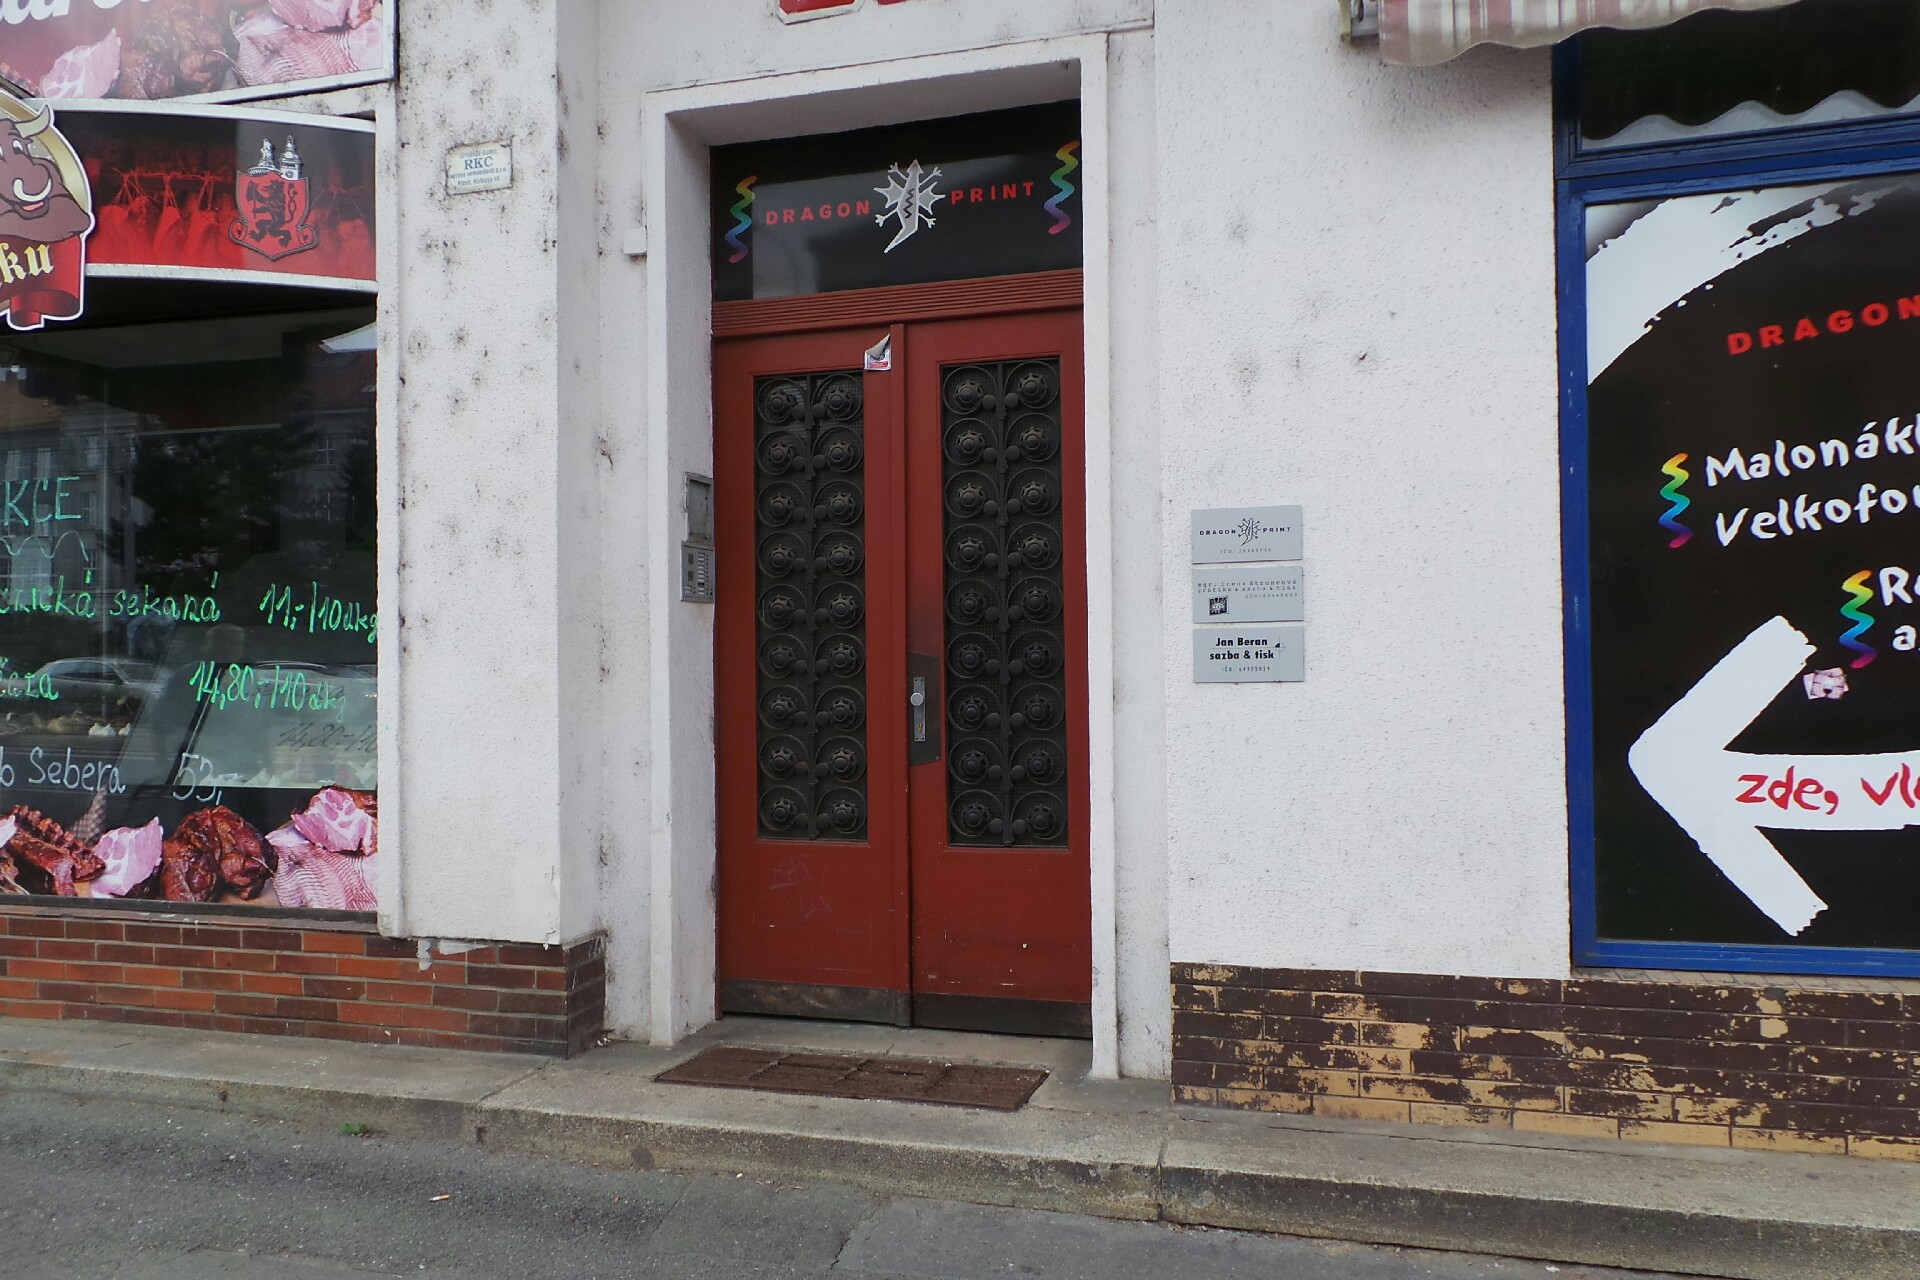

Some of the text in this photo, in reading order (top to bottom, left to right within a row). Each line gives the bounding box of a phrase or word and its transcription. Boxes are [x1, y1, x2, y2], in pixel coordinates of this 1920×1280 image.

[464, 156, 493, 170] RKC
[765, 181, 1035, 226] DRAGON PRINT
[1726, 294, 1920, 355] DRAGON
[1878, 566, 1920, 606] R
[1209, 650, 1274, 660] sazba & tisk
[1215, 637, 1268, 646] Jan Beran
[28, 746, 126, 794] Sebera
[1735, 763, 1920, 815] zde, vl
